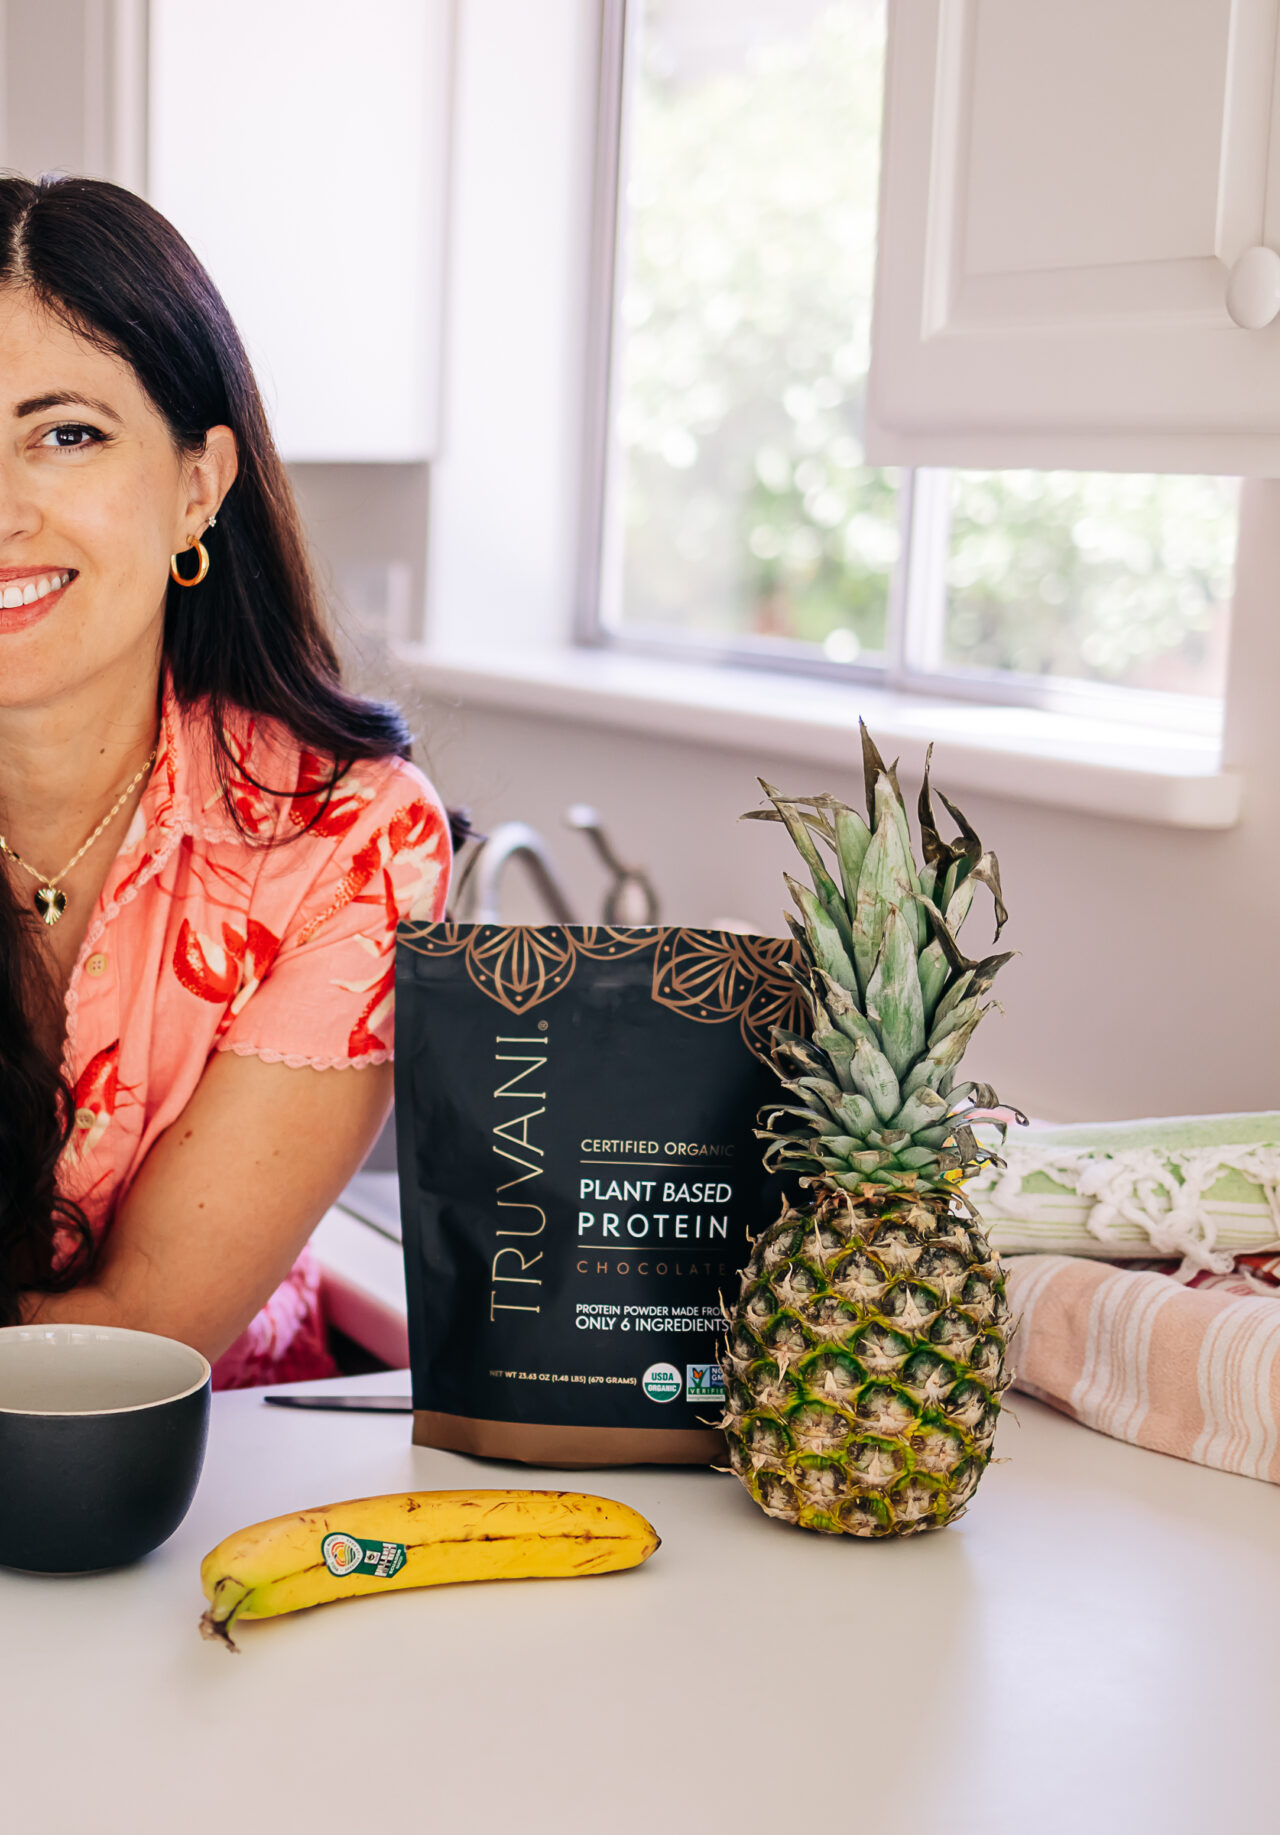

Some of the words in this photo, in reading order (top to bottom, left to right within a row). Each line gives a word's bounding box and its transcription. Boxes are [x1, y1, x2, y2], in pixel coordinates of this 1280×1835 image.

[580, 1139, 659, 1154] CERTIFIED
[664, 1142, 736, 1157] ORGANIC
[490, 1035, 549, 1322] TRUVANI
[580, 1179, 657, 1202] PLANT
[662, 1182, 732, 1203] BASED
[577, 1212, 728, 1239] PROTEIN
[576, 1260, 726, 1276] CHOCOLATE
[576, 1304, 620, 1316] PROTEIN
[623, 1306, 669, 1316] POWDER
[671, 1306, 699, 1316] MADE
[575, 1316, 617, 1331] ONLY
[620, 1318, 631, 1331] 6
[635, 1318, 730, 1332] INGREDIENTS
[489, 1370, 504, 1378] NET
[505, 1371, 517, 1379] WT
[518, 1372, 538, 1381] 23.63
[538, 1373, 550, 1381] OZ
[552, 1374, 569, 1383] (1.48
[570, 1375, 587, 1384] LBS)
[588, 1375, 604, 1384] (670
[605, 1376, 638, 1386] GRAMS)
[651, 1372, 674, 1381] USDA
[647, 1384, 677, 1392] ORGANIC
